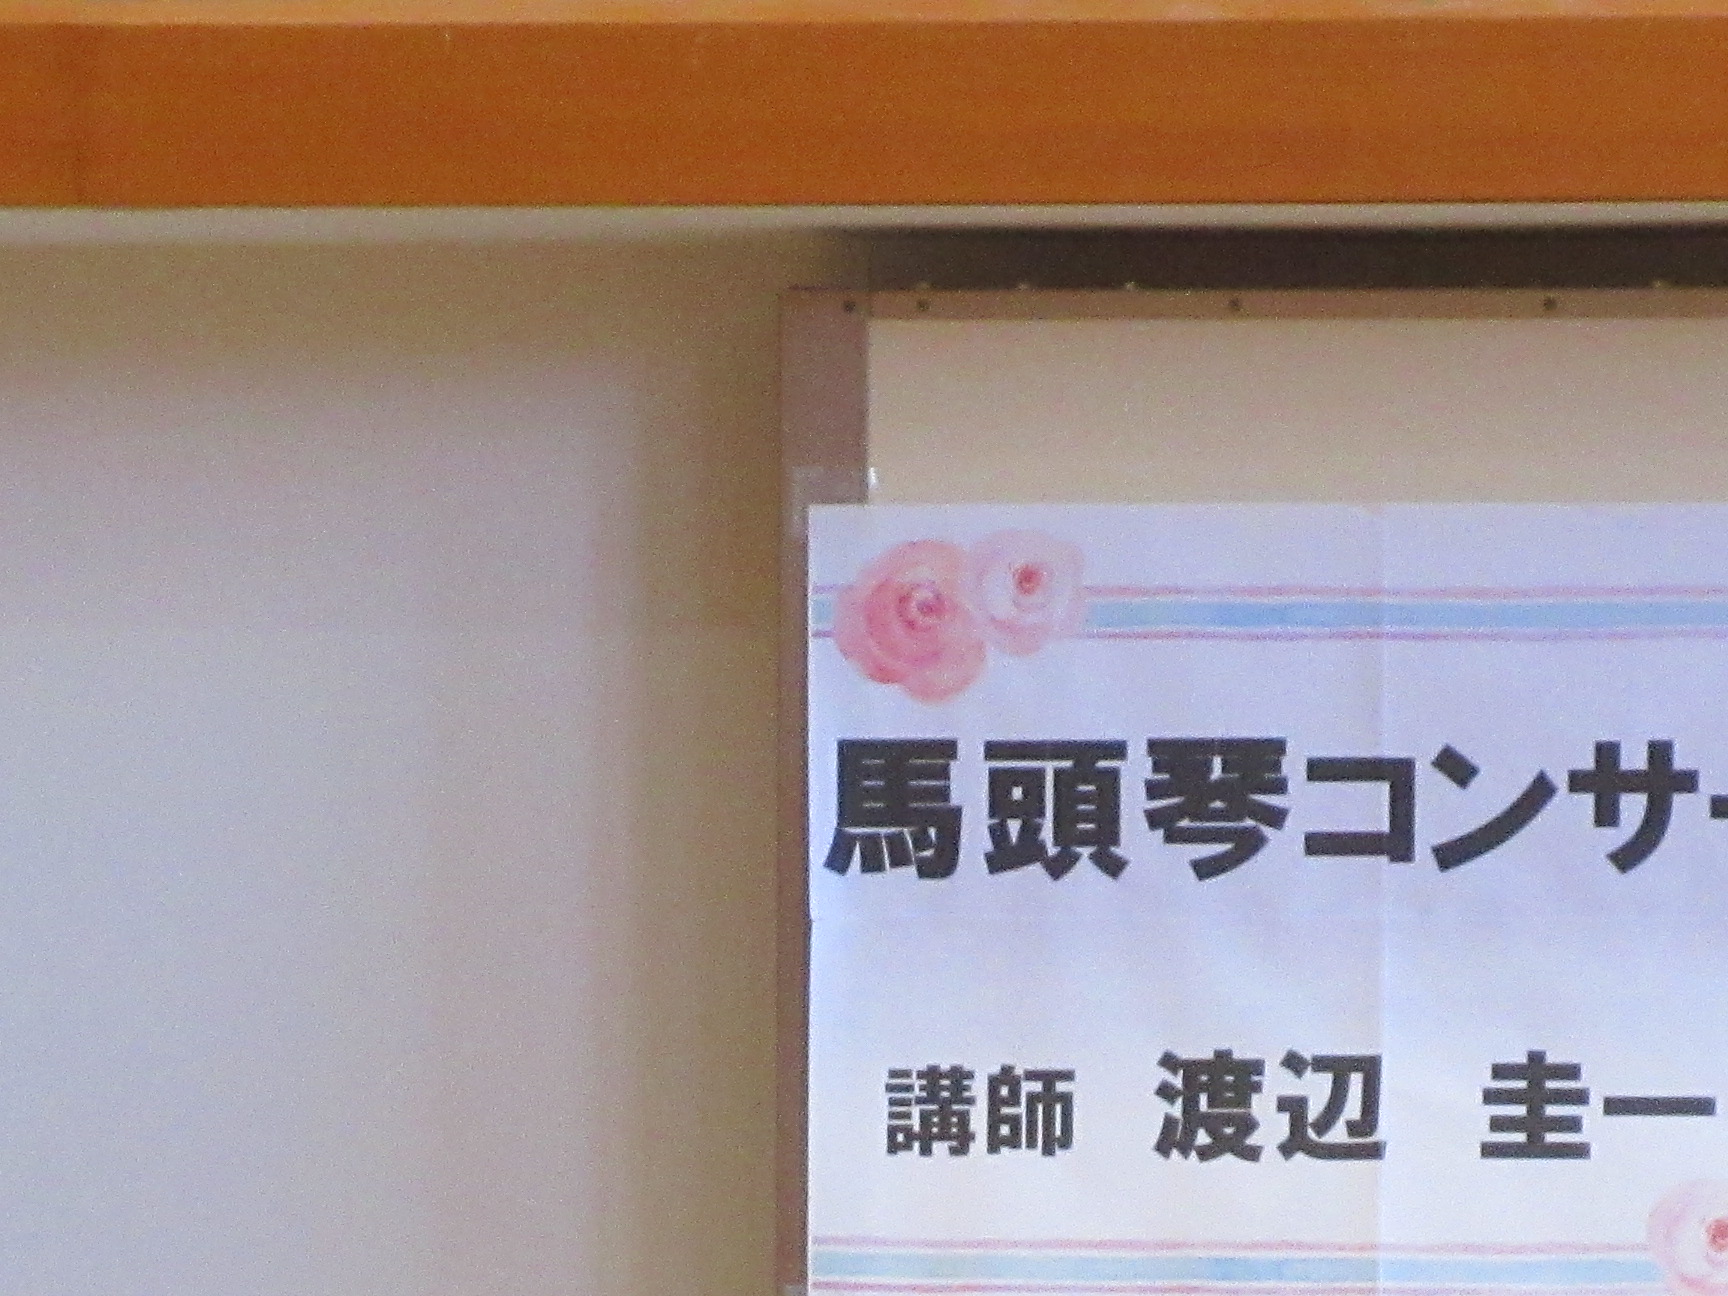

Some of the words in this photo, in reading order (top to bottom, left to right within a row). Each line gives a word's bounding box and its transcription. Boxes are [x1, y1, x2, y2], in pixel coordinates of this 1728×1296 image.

[884, 1064, 1076, 1157] 講師
[1153, 1048, 1385, 1162] 渡辺
[1479, 1049, 1717, 1160] 圭一
